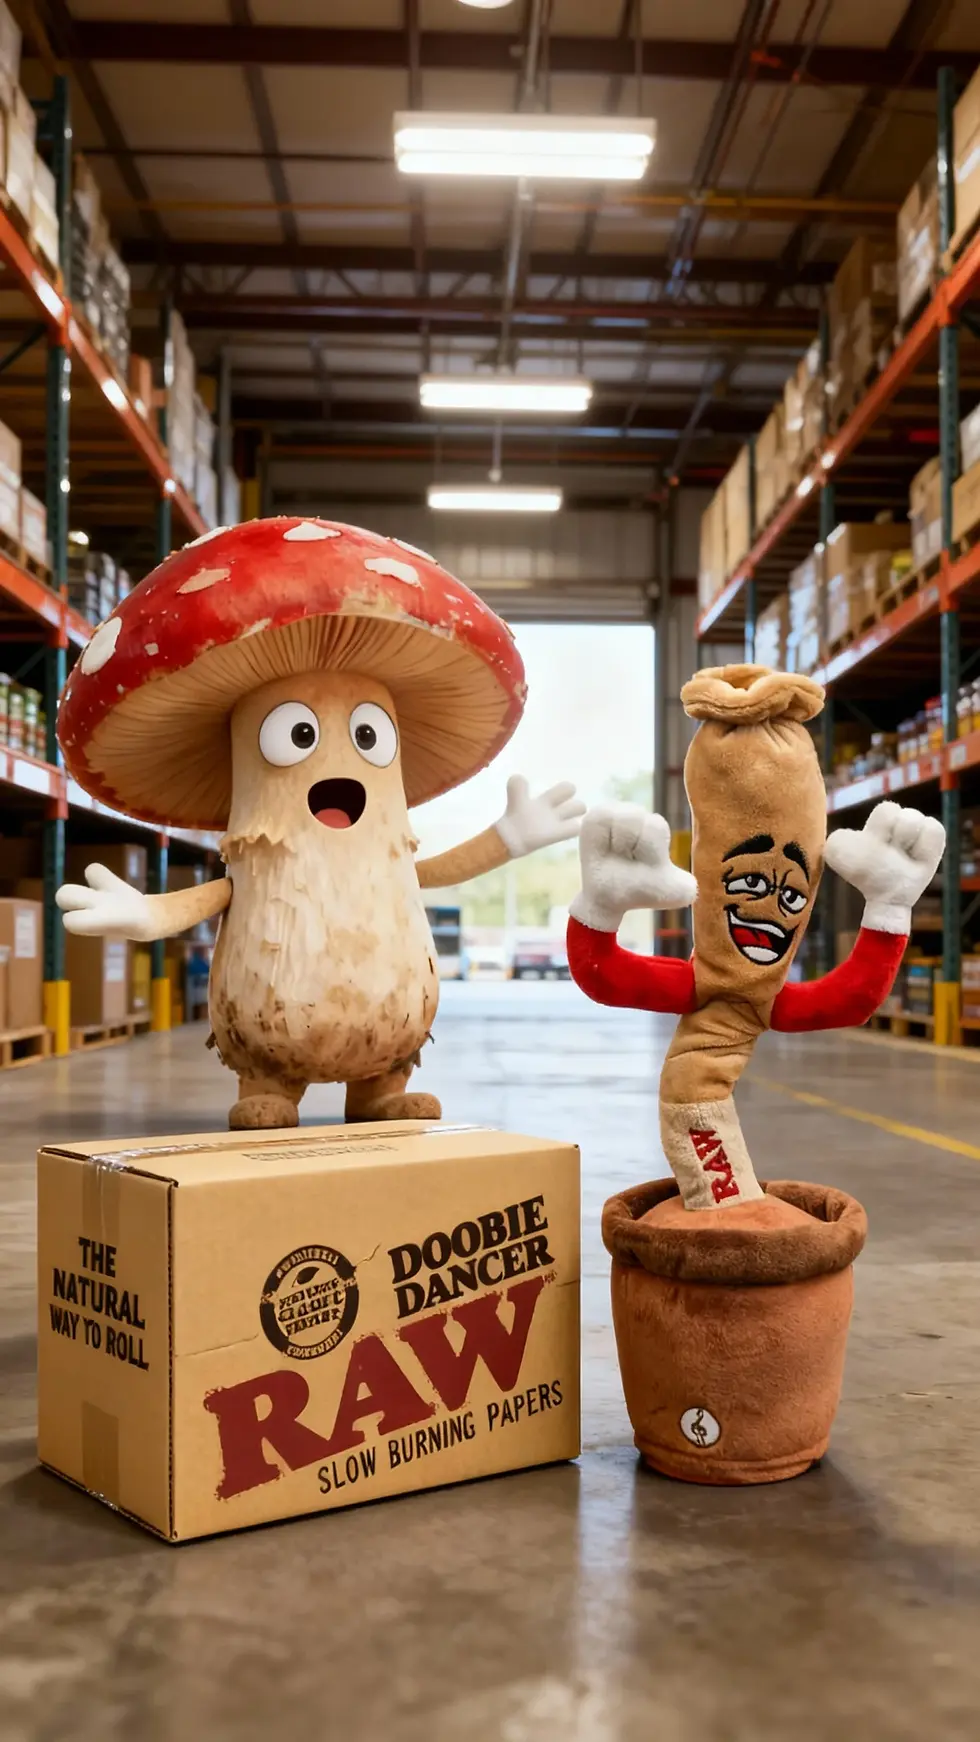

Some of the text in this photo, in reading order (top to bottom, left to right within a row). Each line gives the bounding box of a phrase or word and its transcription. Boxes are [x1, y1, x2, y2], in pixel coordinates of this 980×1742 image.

[689, 1127, 740, 1204] RAW
[78, 1236, 117, 1278] THE
[388, 1195, 548, 1284] DOOBIE
[394, 1235, 555, 1319] DANCER
[50, 1303, 80, 1340] WAY
[106, 1325, 150, 1371] ROLL
[53, 1267, 146, 1330] NATURAL
[203, 1273, 550, 1501] RAW
[317, 1380, 563, 1495] SLOW BURNING PAPERS
